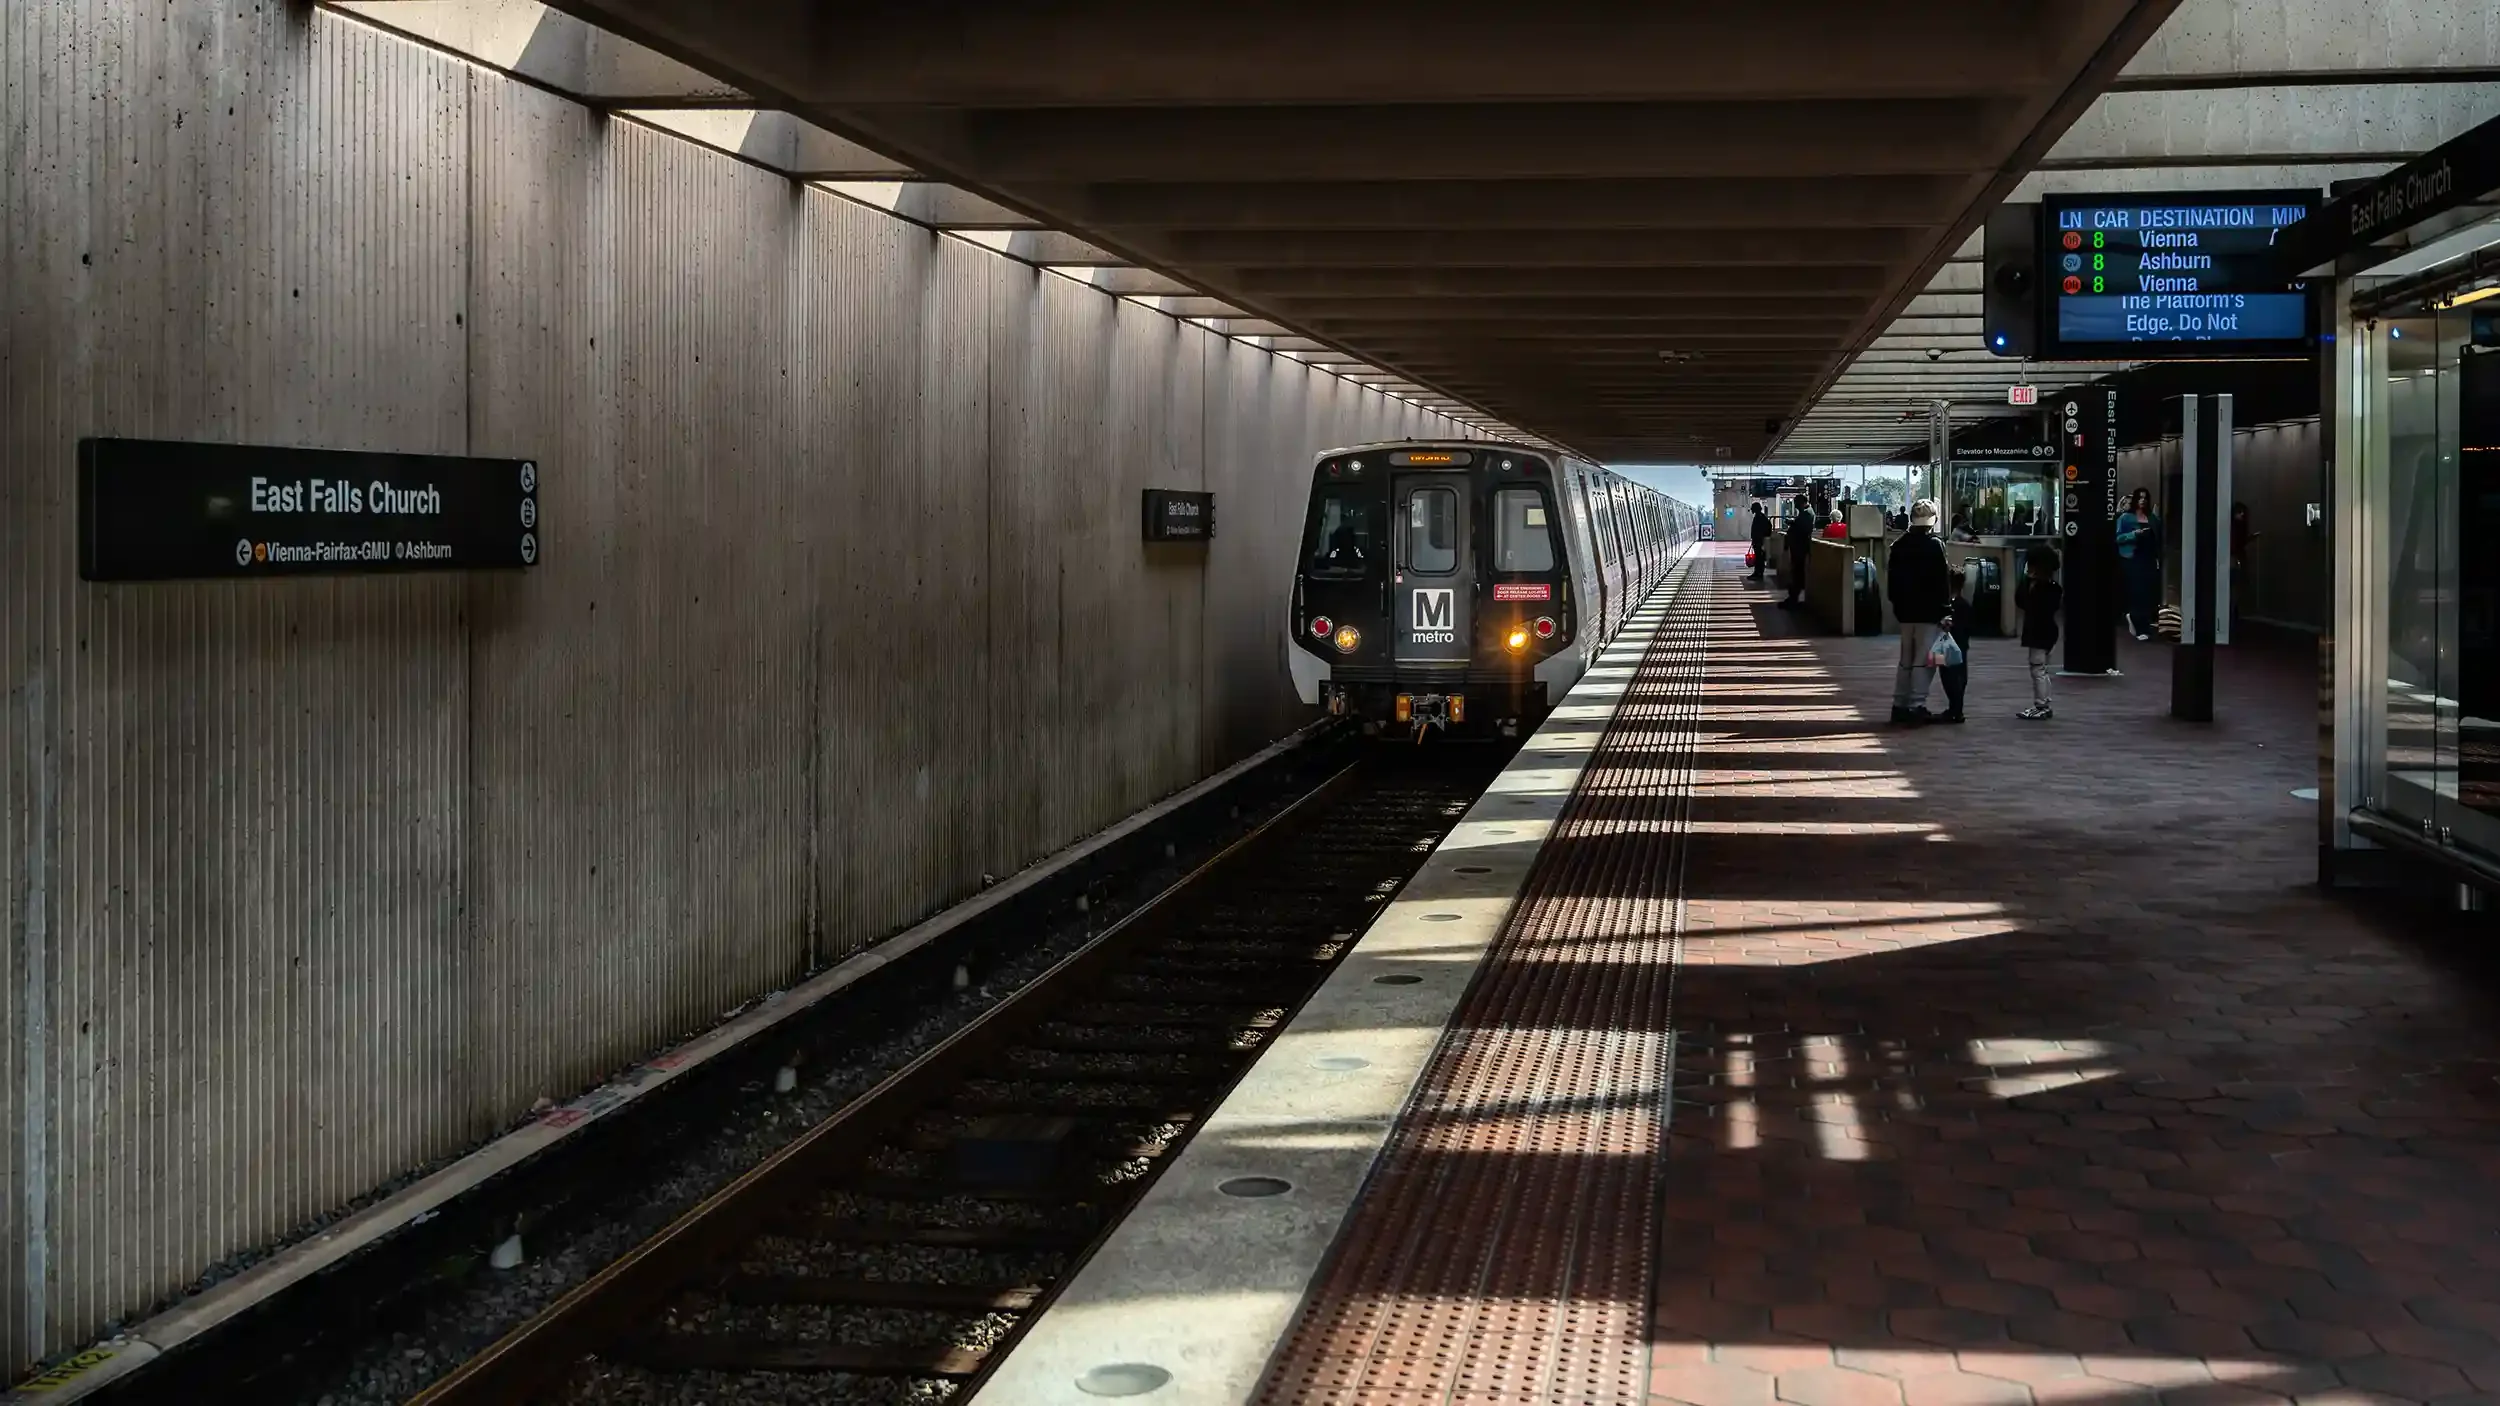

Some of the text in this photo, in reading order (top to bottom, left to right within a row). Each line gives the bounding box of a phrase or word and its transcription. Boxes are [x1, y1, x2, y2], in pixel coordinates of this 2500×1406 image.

[2351, 158, 2452, 235] East Falls Church
[2060, 207, 2306, 228] LN CAR DESTINATION MIN
[2093, 232, 2104, 248] 8
[2138, 231, 2198, 248] Vienna
[2093, 254, 2104, 271] 8
[2138, 252, 2211, 270] Ashburn
[2093, 276, 2104, 292] 8
[2138, 275, 2198, 292] Vienna
[2127, 313, 2238, 334] Edge. Do Not
[2013, 387, 2033, 403] EXIT
[2107, 391, 2117, 521] East Falls Church
[251, 476, 441, 515] East Falls Church
[267, 541, 390, 562] Vienna-Fairfax-GMU
[405, 541, 452, 560] Ashburn
[1415, 591, 1451, 627] M
[1413, 631, 1453, 643] metro
